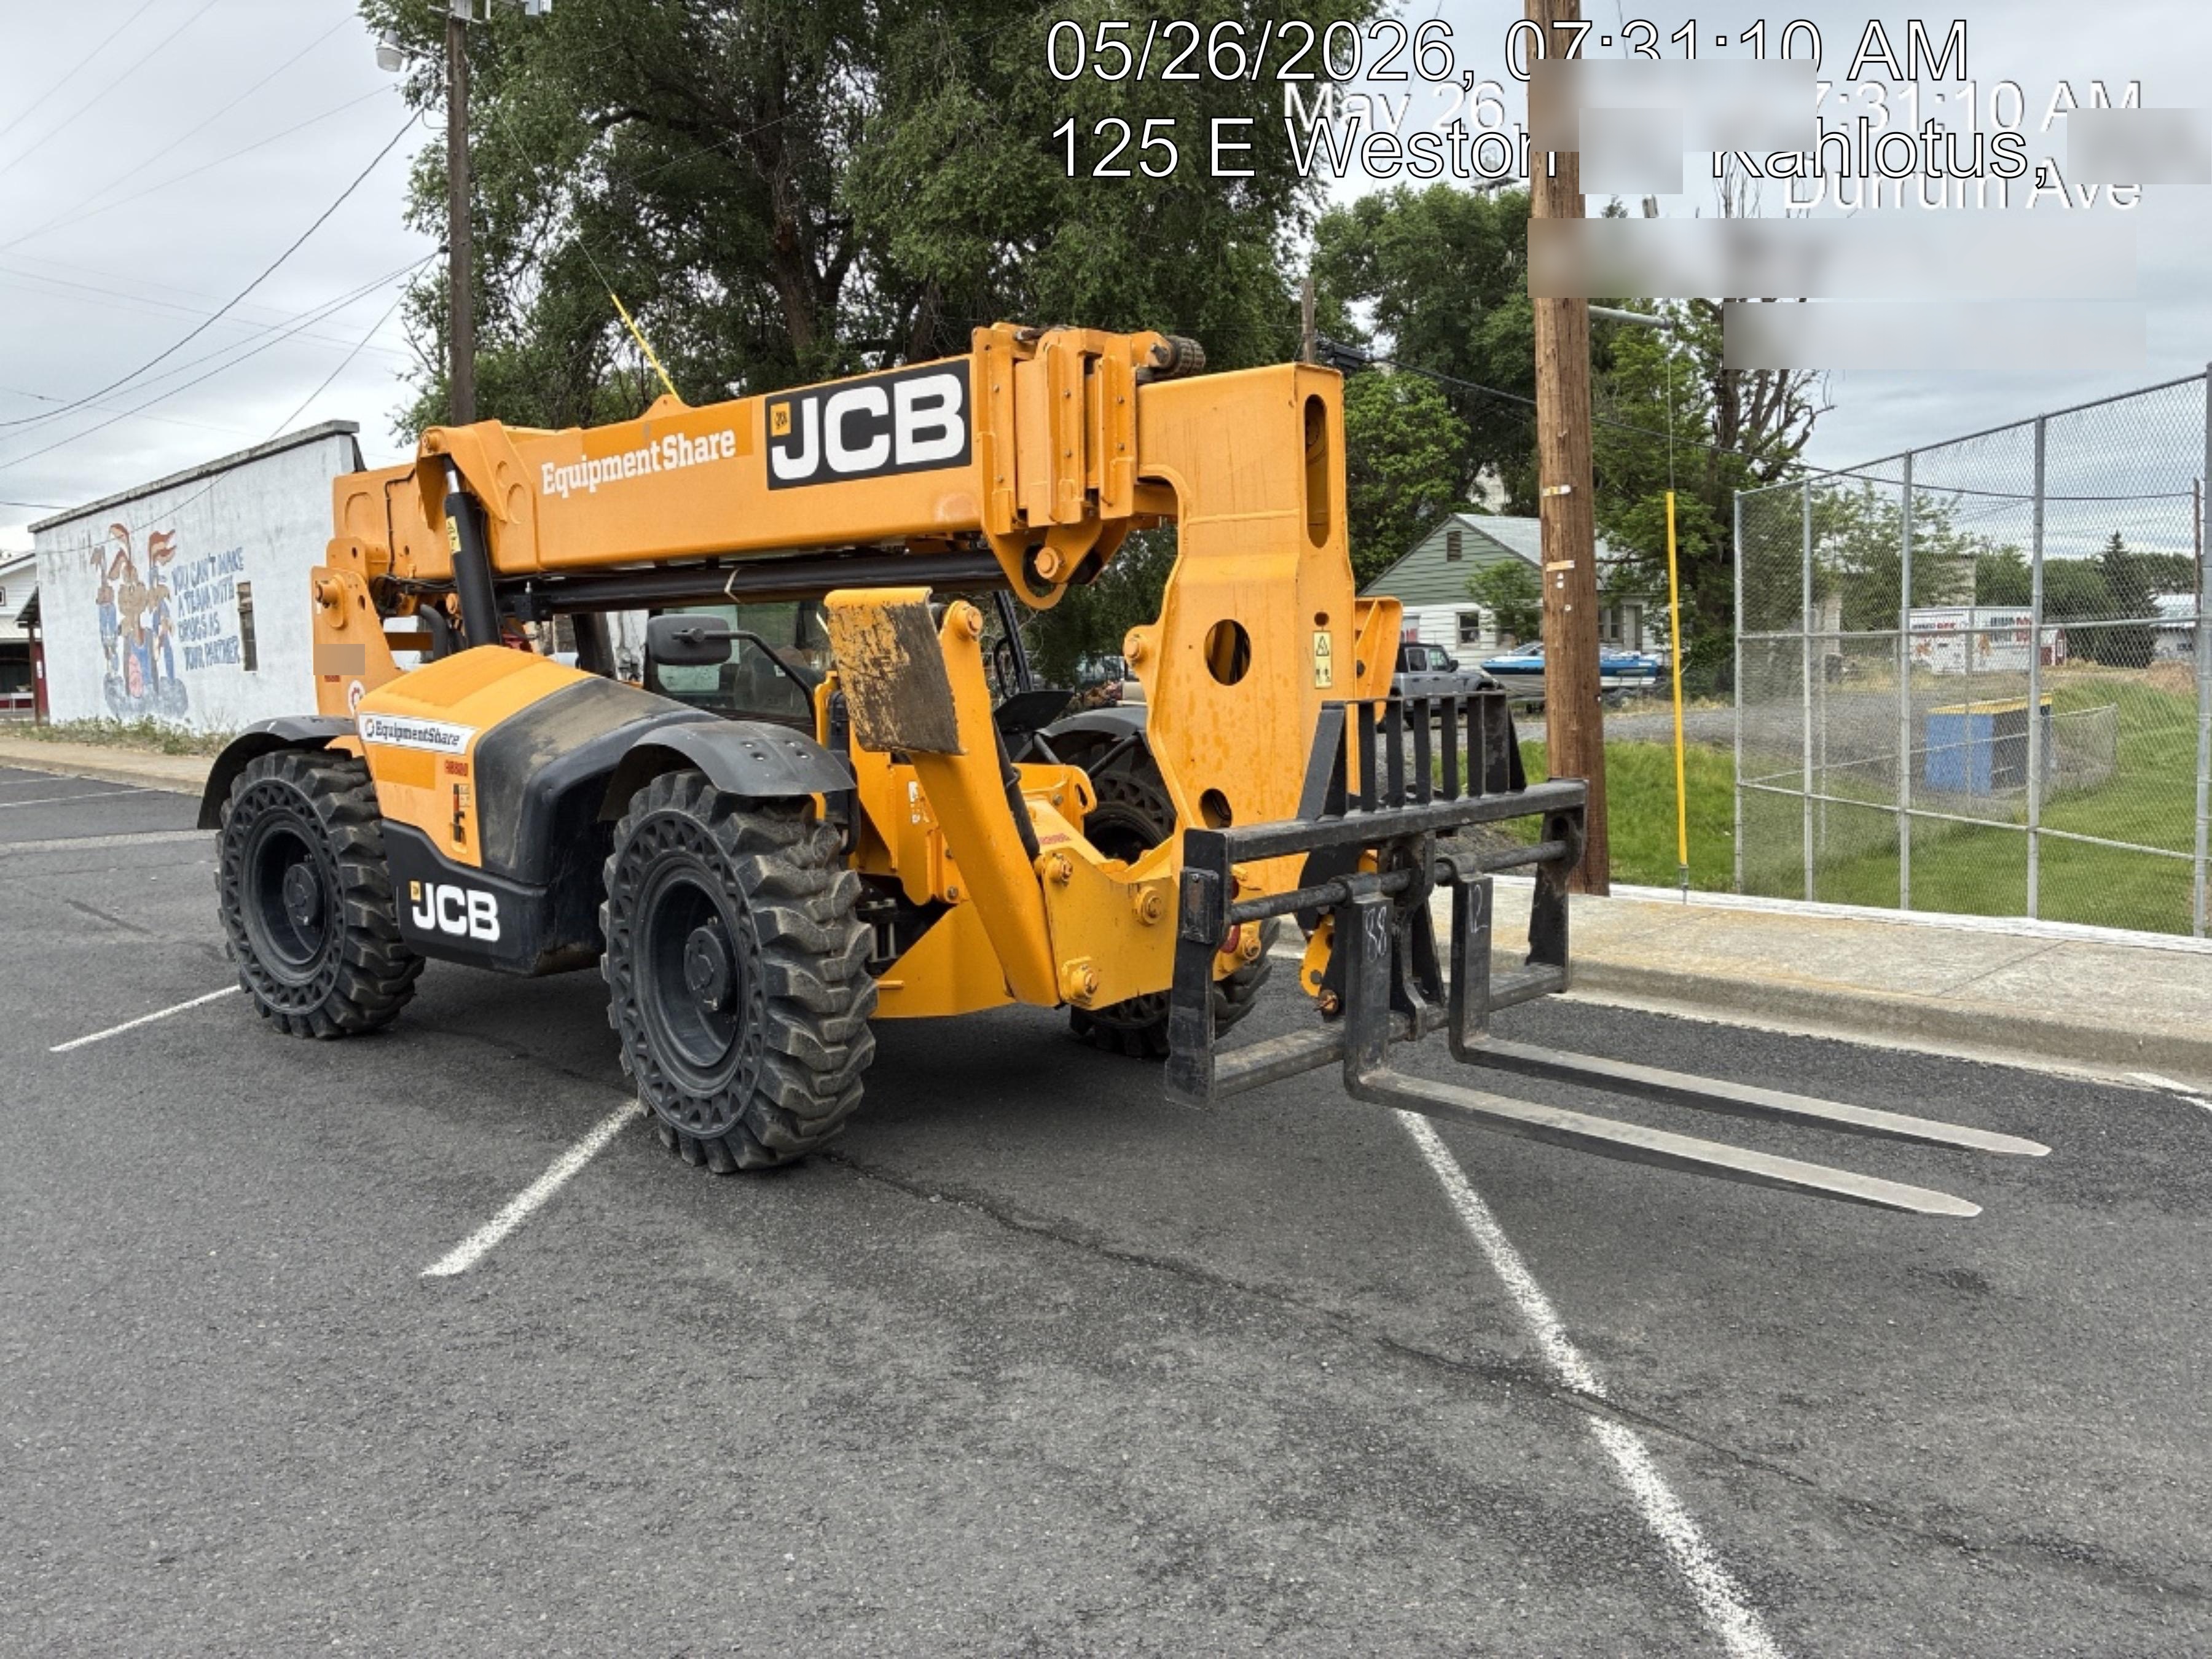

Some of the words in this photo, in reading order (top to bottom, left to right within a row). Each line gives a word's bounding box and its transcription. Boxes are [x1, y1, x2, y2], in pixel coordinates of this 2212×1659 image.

[772, 374, 965, 480] JCB
[541, 429, 736, 498] EquipmentShare
[375, 720, 460, 746] EquipmentShare
[412, 882, 501, 943] JCB
